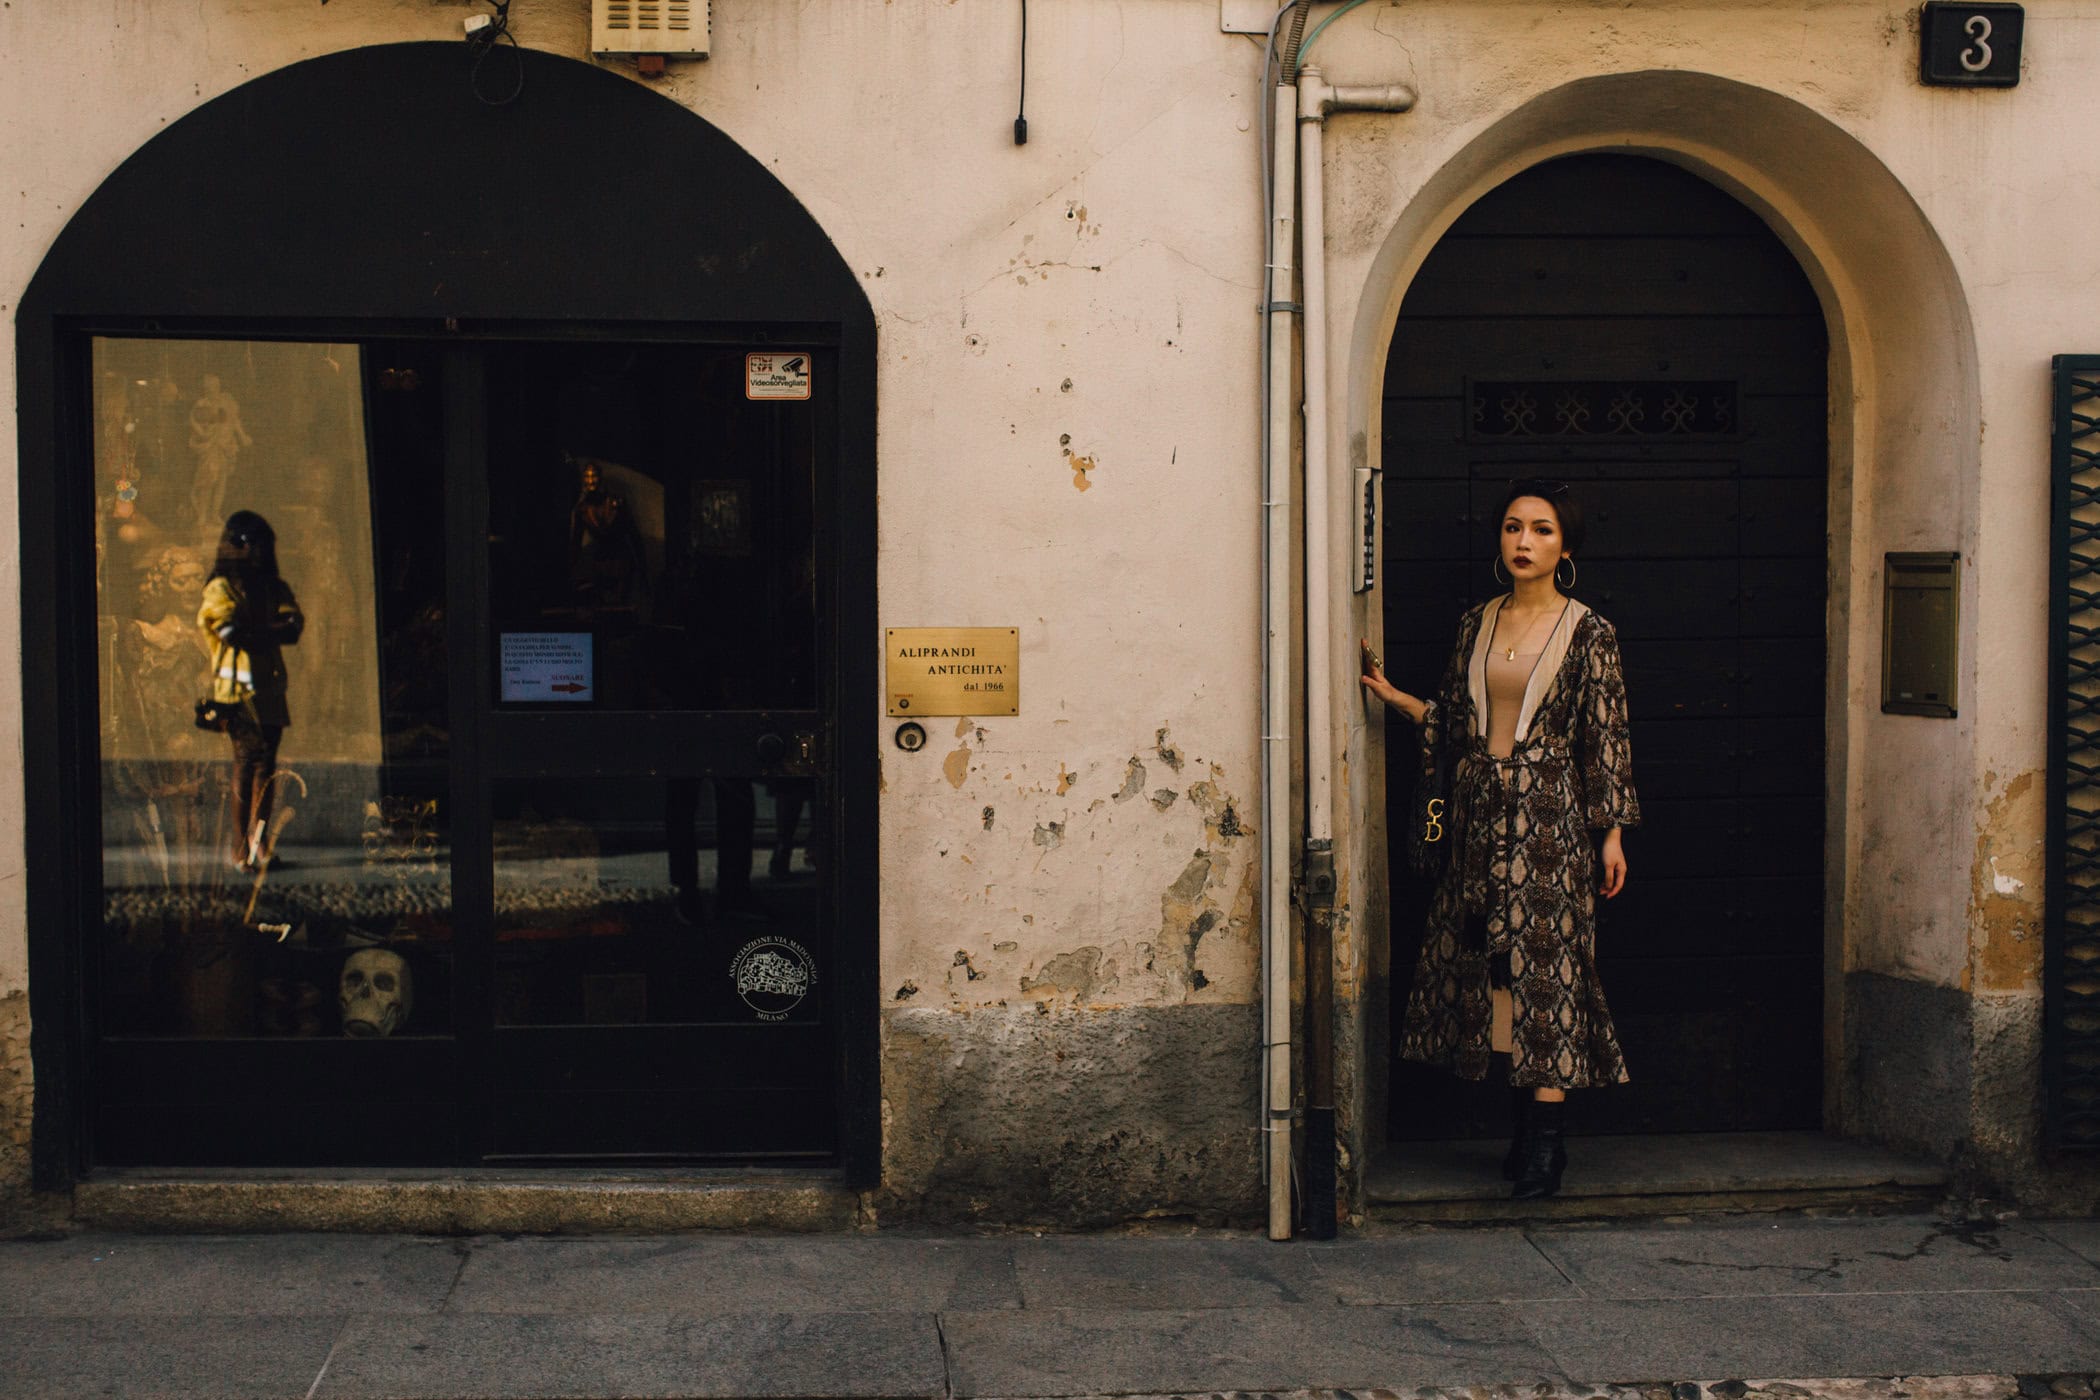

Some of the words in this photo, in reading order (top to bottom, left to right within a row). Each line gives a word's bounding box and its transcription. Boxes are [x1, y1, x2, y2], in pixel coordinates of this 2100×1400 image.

[1960, 15, 1993, 72] 3
[750, 380, 807, 388] Videosorvegliata
[899, 647, 976, 658] ALIPRANDI
[927, 664, 1007, 675] ANTICHITA'
[963, 682, 979, 691] dal
[984, 682, 1004, 691] 1966
[728, 935, 772, 978] ASSOCIAZIONE
[774, 935, 787, 944] VIA
[755, 1012, 789, 1022] MILANO
